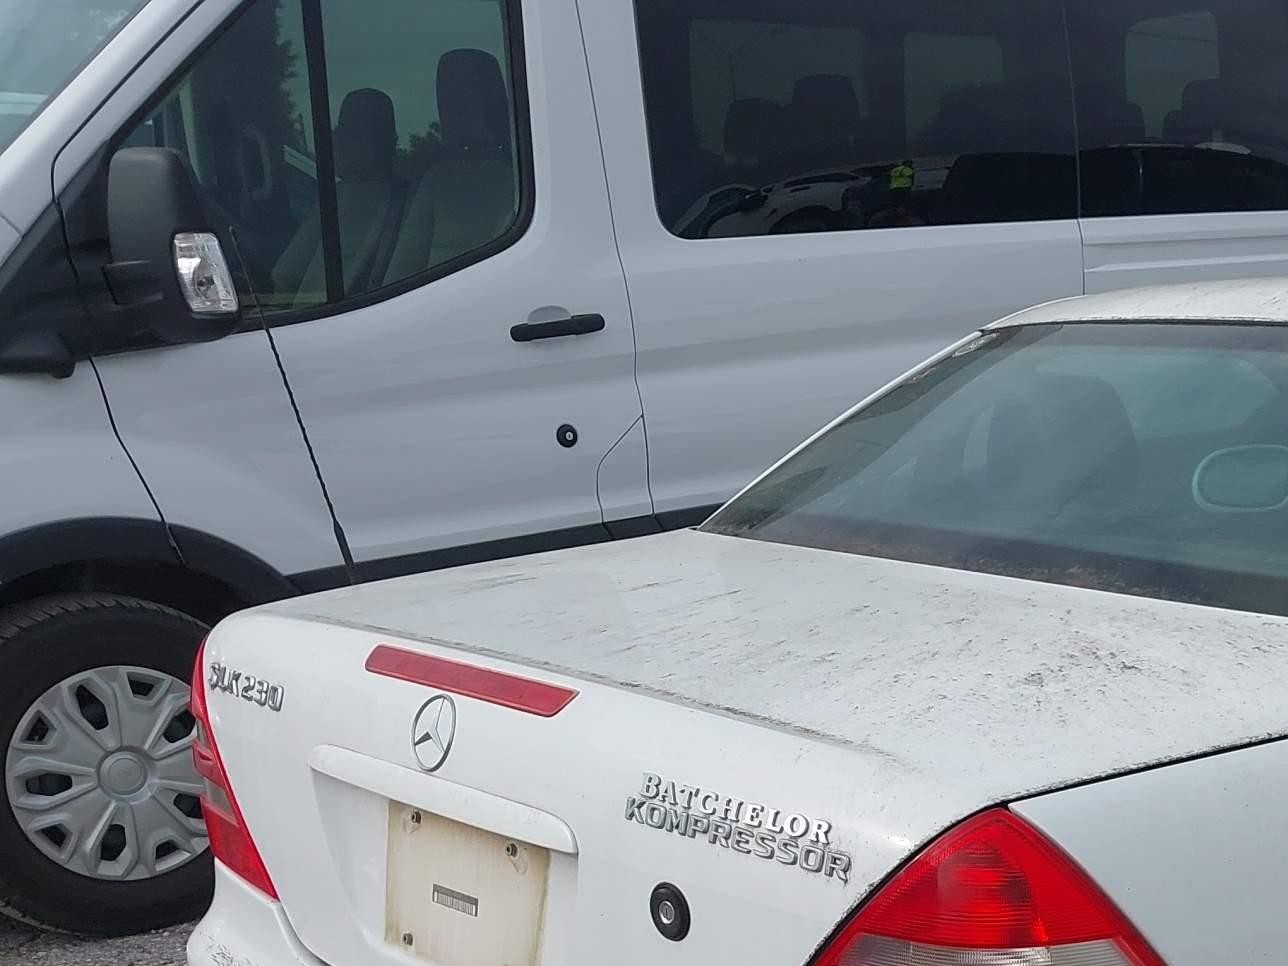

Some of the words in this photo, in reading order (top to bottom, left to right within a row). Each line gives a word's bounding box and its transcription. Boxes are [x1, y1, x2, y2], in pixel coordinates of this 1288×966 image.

[241, 675, 285, 712] 230
[625, 796, 852, 883] KOMPRESSOR
[640, 771, 832, 845] BATCHELOR
